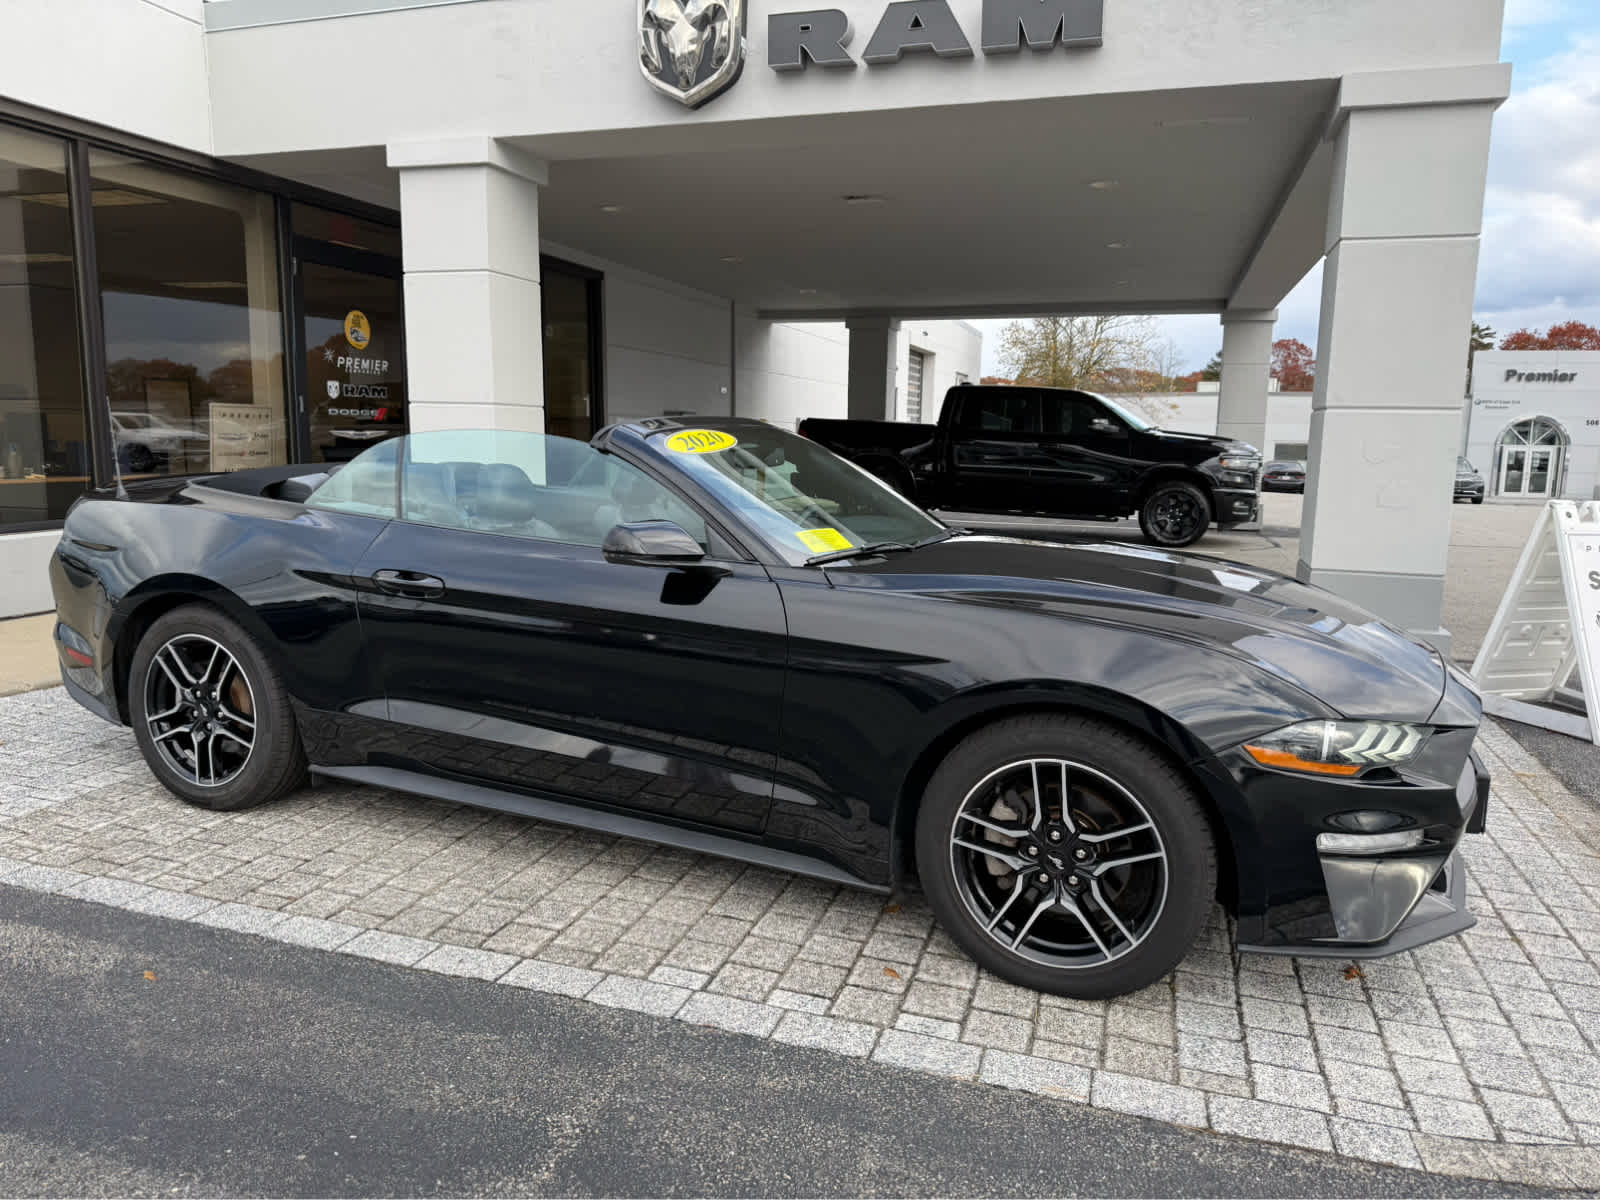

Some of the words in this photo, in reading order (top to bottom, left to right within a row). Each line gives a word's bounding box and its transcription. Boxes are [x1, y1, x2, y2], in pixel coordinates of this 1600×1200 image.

[768, 0, 1103, 72] RAM
[337, 356, 389, 373] PREMIER
[1504, 369, 1578, 383] Premier
[343, 384, 388, 399] RAM
[676, 431, 725, 451] 2020
